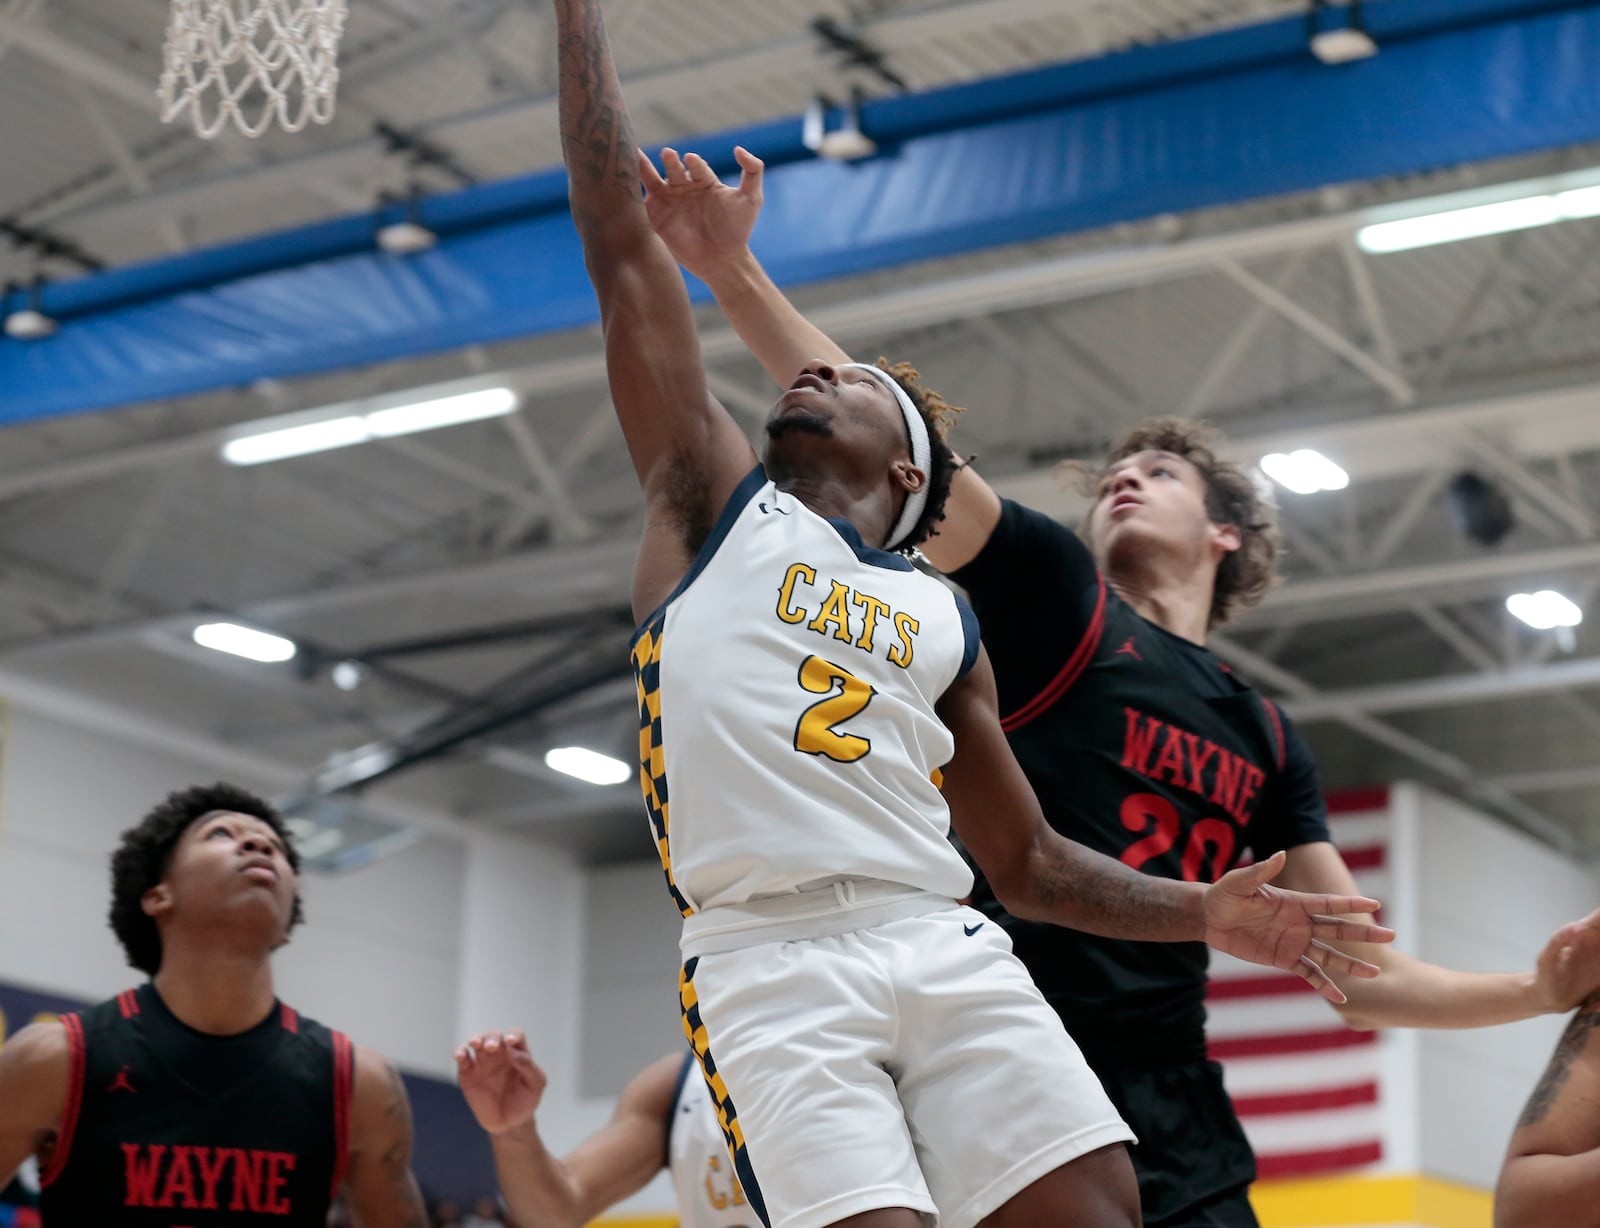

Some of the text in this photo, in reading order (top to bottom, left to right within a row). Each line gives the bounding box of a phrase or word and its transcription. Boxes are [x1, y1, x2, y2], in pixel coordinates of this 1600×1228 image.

[776, 562, 920, 669] CATS
[794, 654, 879, 764] 2
[1120, 706, 1266, 827] WAYNE
[1119, 792, 1235, 883] 20
[120, 1142, 297, 1215] WAYNE
